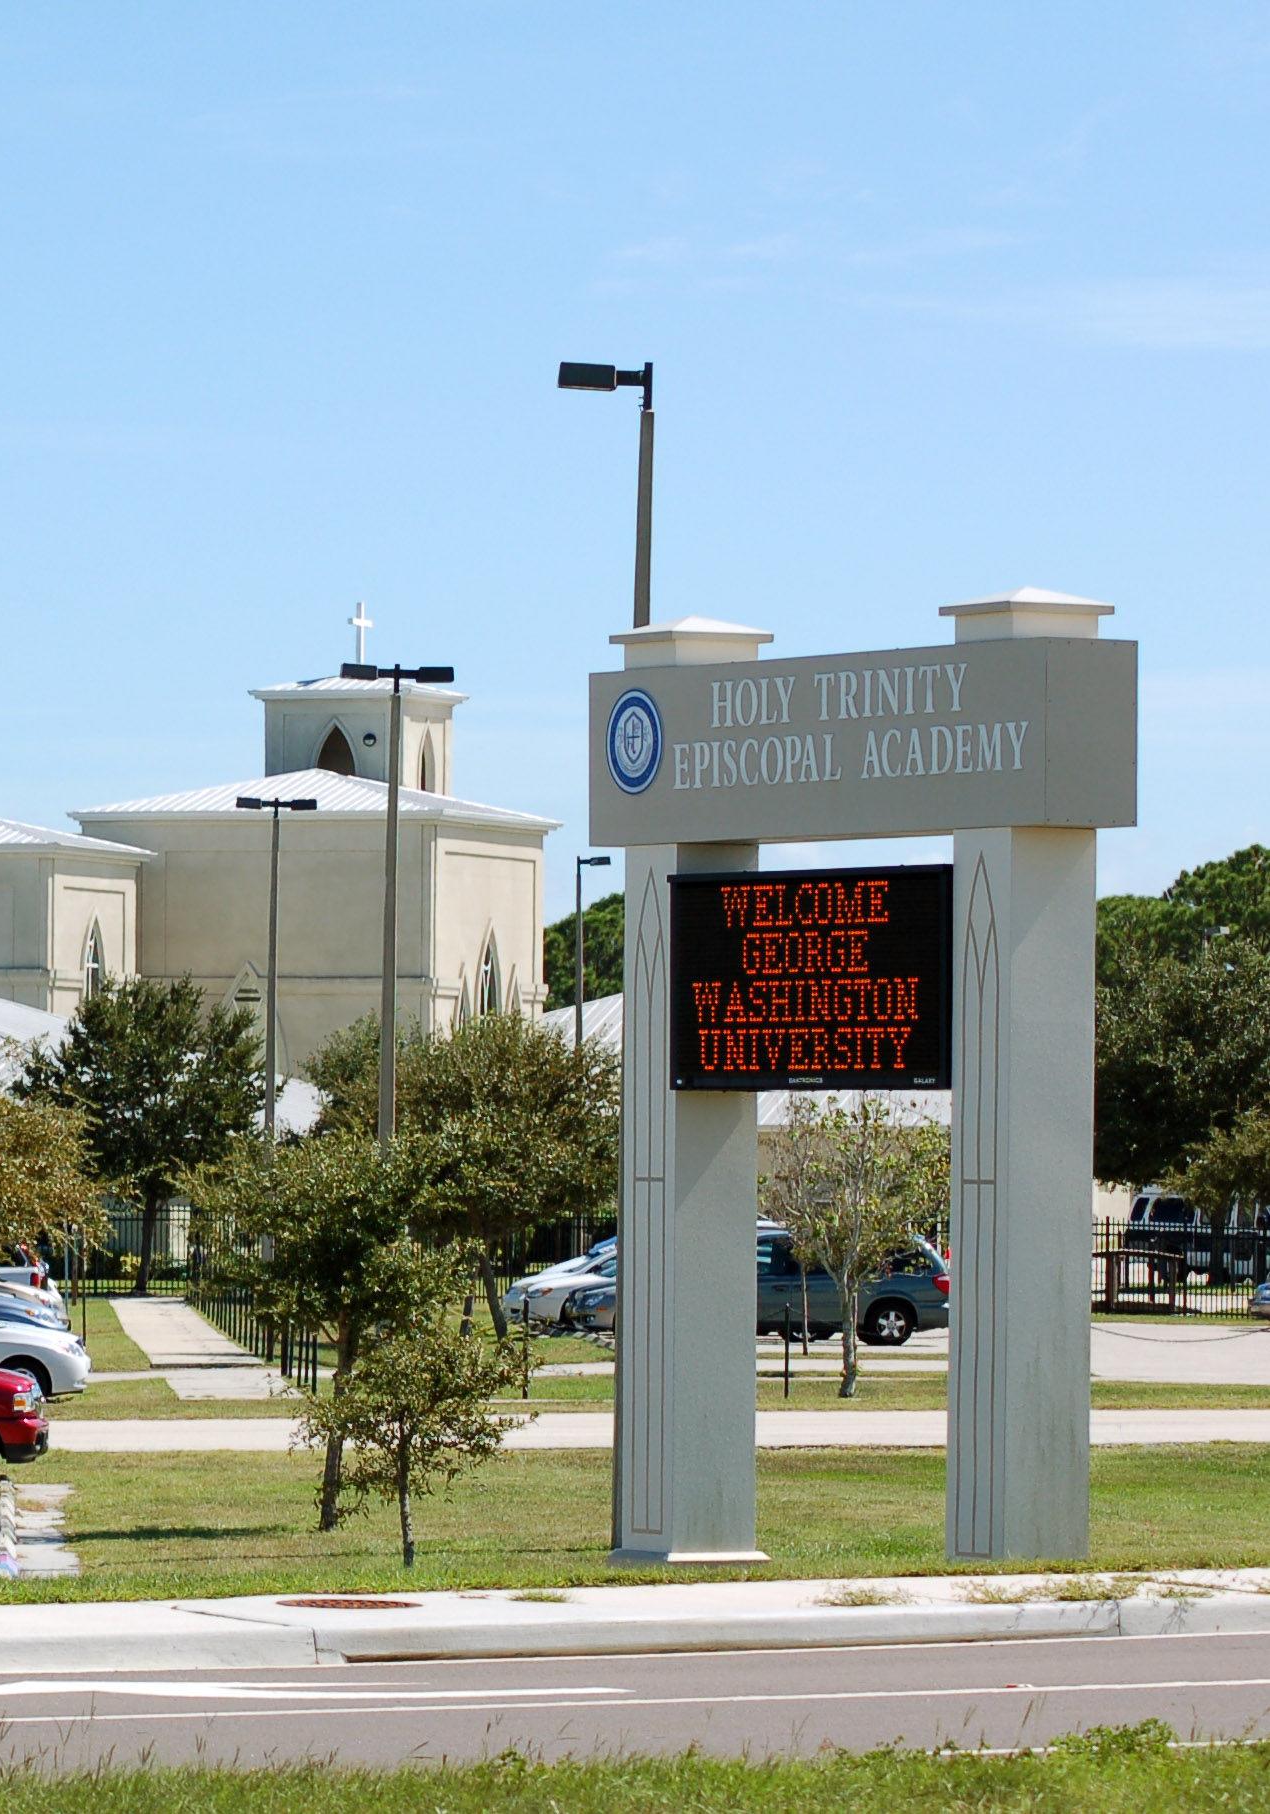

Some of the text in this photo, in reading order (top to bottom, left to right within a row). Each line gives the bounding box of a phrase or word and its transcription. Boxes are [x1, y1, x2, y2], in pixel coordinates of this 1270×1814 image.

[710, 663, 967, 728] HOLY TRINITY
[673, 733, 842, 790] EPISCOPAL
[861, 720, 1029, 779] ACADEMY
[721, 880, 889, 927] WELCOME
[742, 929, 868, 974] GEORGE
[692, 977, 918, 1023] WASHINGTON
[698, 1026, 911, 1071] UNIVERSITY
